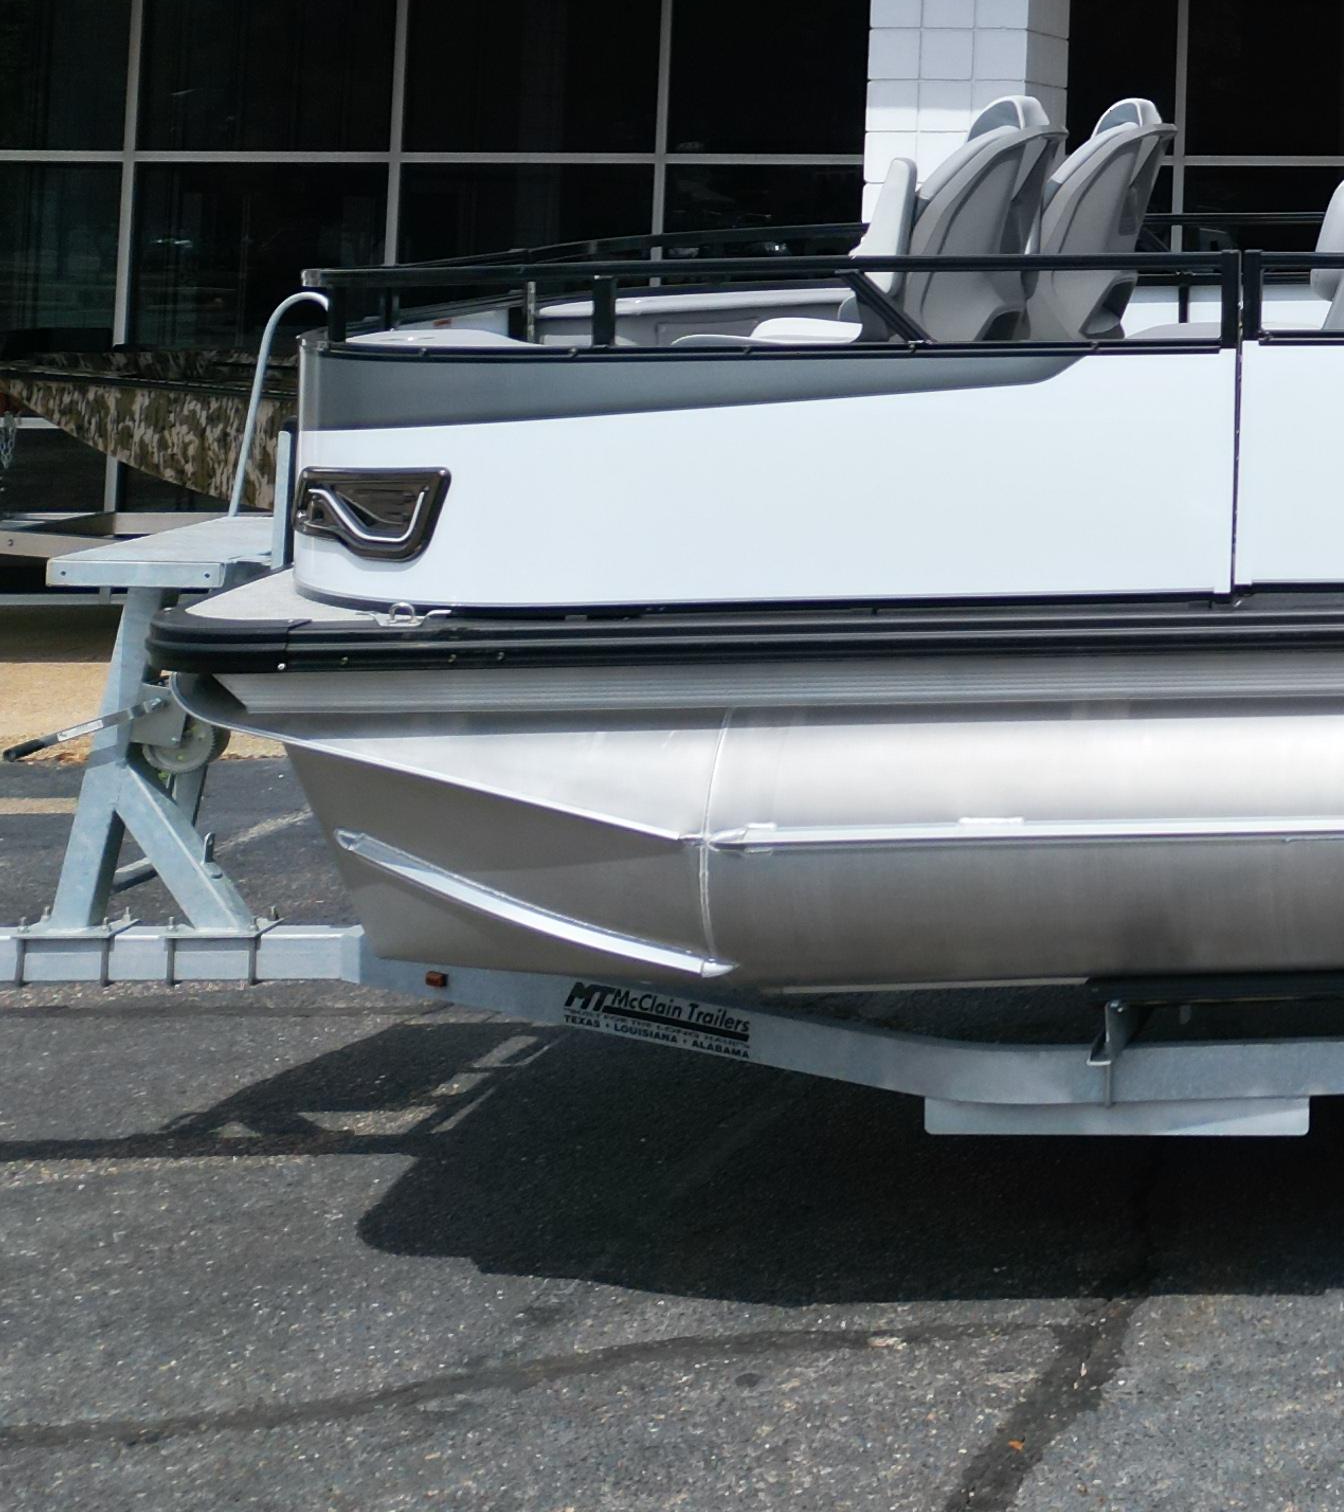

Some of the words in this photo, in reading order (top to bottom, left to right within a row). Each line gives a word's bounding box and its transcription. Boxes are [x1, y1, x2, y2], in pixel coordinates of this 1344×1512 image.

[564, 981, 616, 1012] MT
[611, 989, 683, 1019] McClain
[687, 1002, 751, 1034] Trailers
[564, 1014, 600, 1028] TEXAS
[614, 1023, 678, 1043] LOUISIANA
[692, 1039, 750, 1059] ALABAMA
